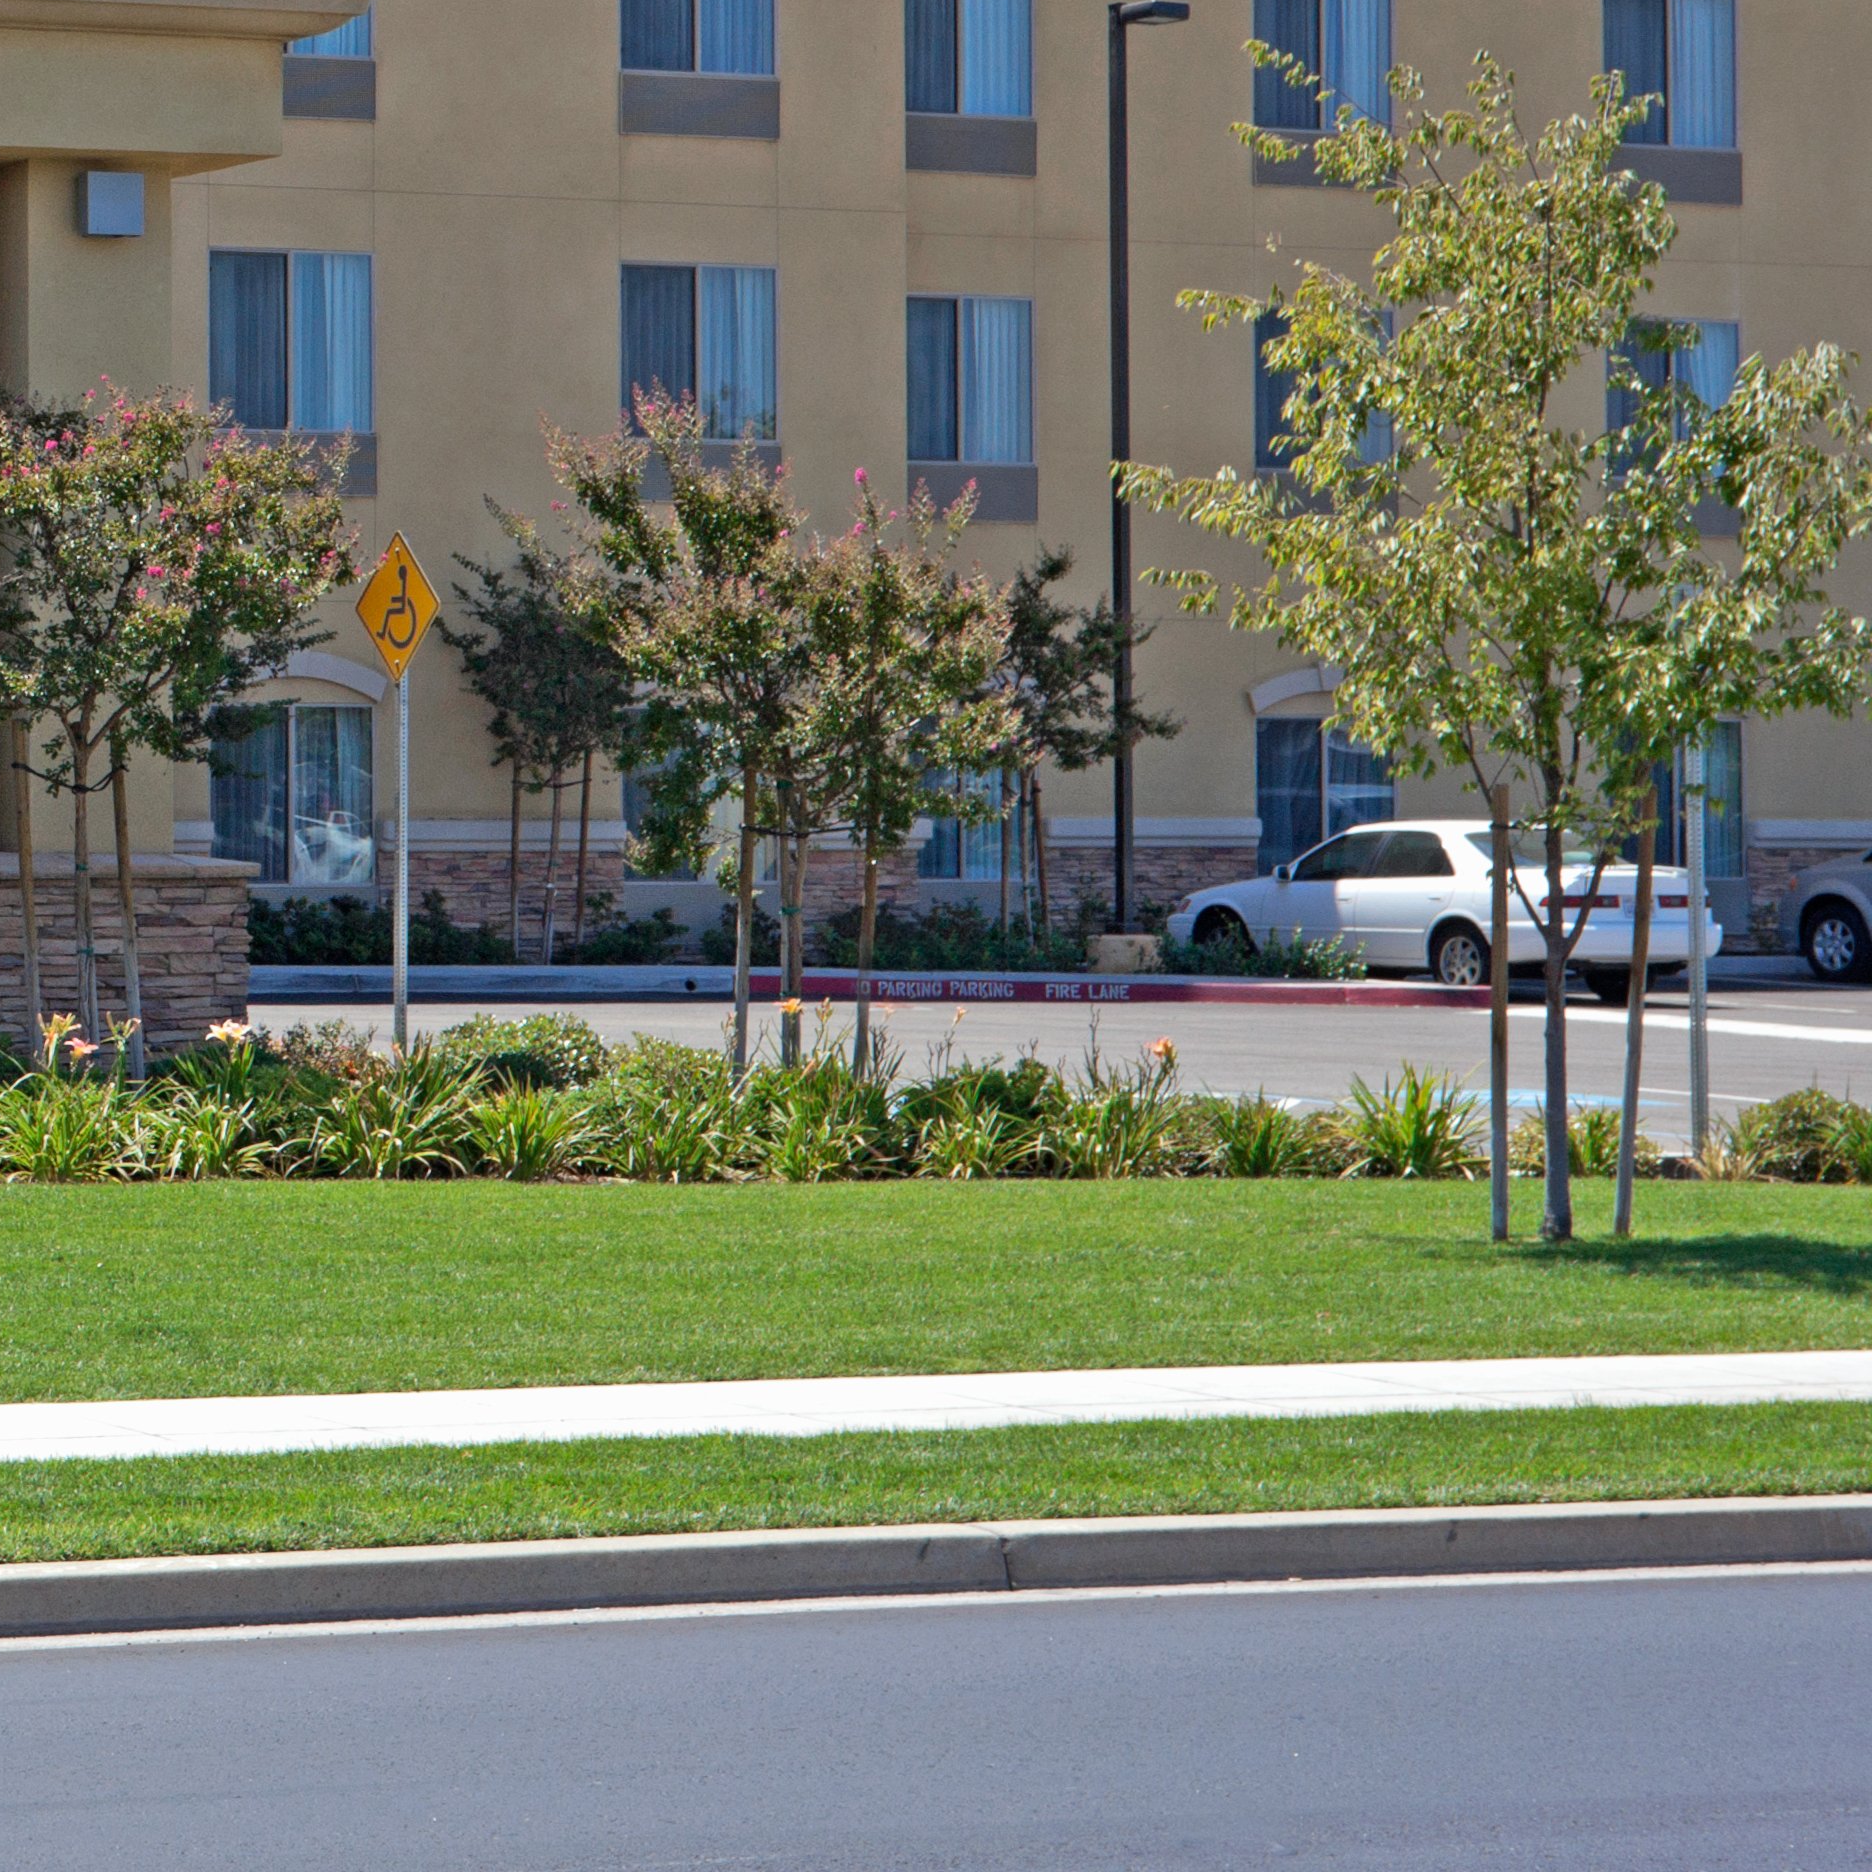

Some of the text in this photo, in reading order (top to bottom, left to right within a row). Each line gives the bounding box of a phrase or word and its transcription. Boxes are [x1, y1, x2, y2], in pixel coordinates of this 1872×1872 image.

[950, 980, 1014, 999] PARKING
[1045, 983, 1081, 999] FIRE
[1088, 984, 1129, 1000] LANE
